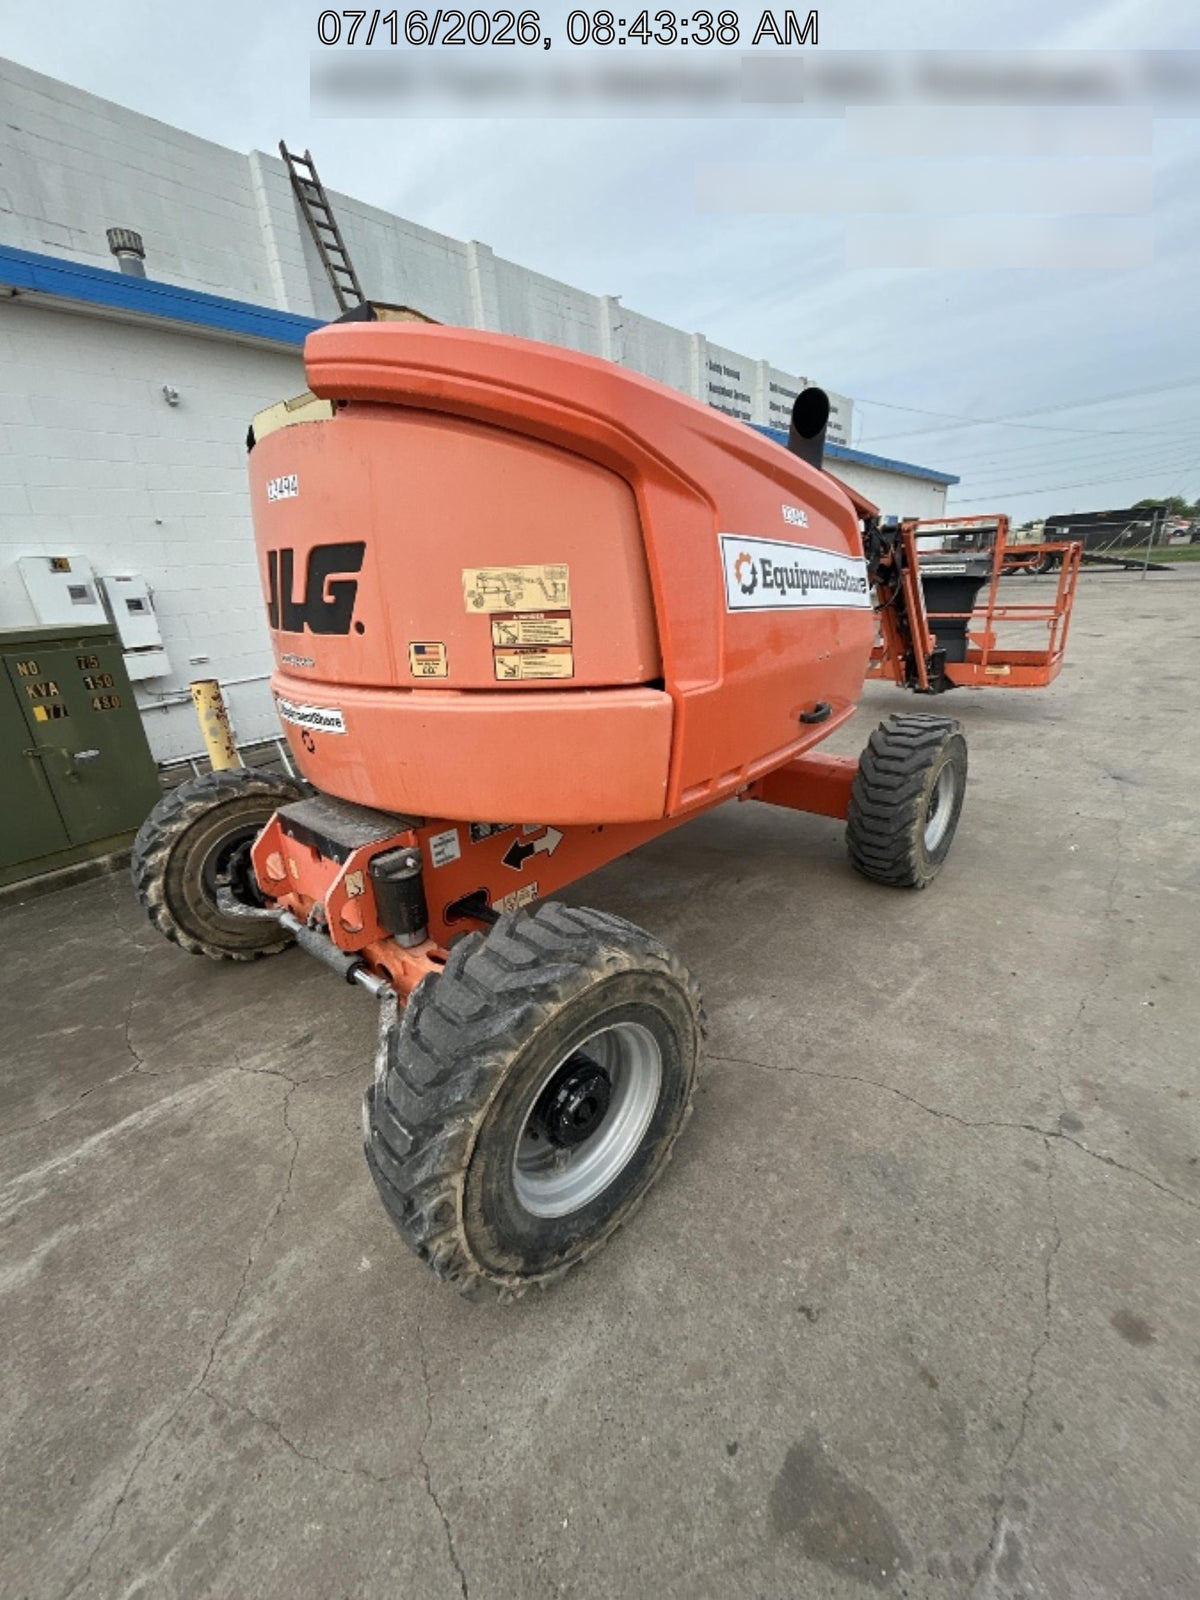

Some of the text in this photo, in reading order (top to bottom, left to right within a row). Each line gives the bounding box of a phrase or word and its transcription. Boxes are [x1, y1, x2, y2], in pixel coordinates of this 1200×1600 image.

[759, 557, 867, 596] EquipmentShare
[26, 676, 114, 698] KVA 150
[92, 696, 122, 711] 480
